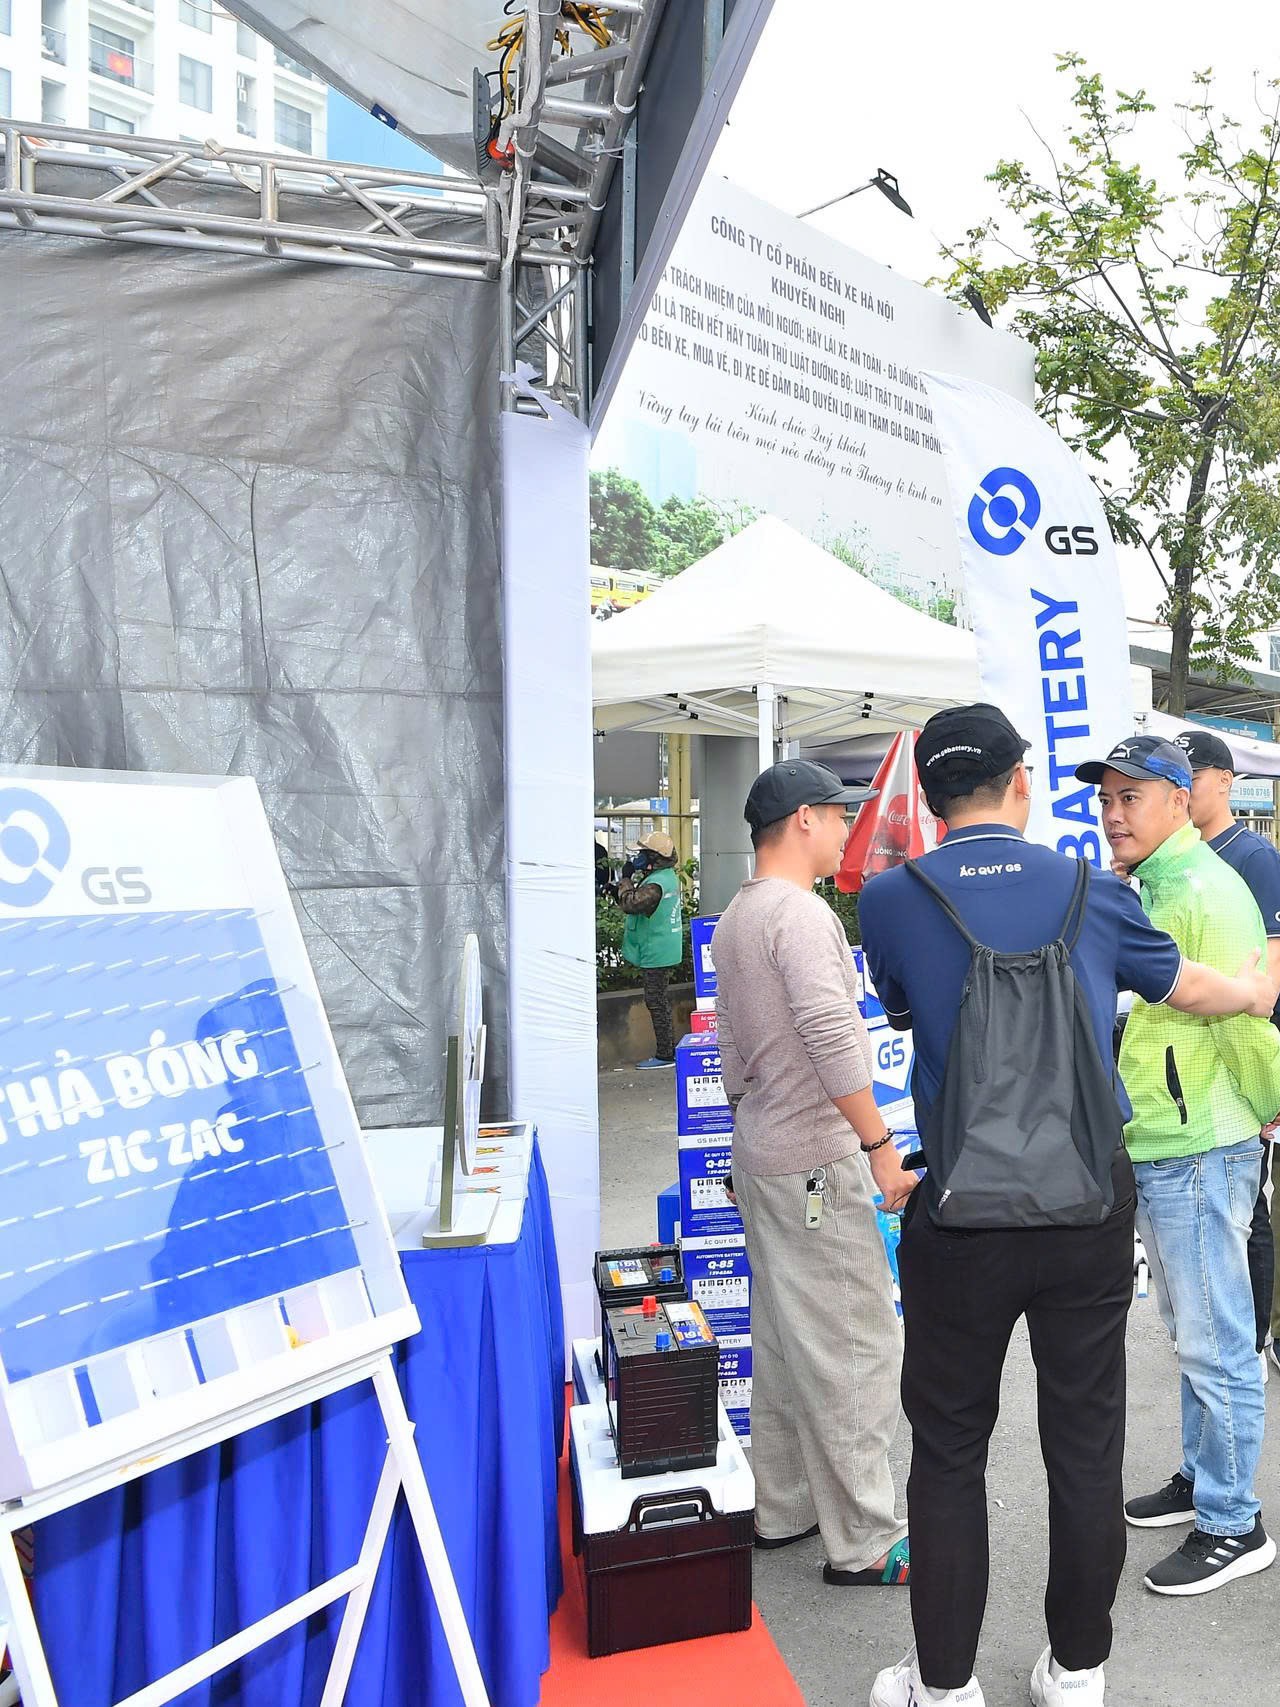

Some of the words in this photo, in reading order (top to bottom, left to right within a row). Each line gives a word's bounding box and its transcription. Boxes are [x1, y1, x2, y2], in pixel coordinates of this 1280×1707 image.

[711, 216, 745, 248] CÔNG
[749, 234, 763, 256] TY
[767, 242, 782, 266] CỔ
[820, 270, 841, 296] BẾN
[845, 282, 857, 304] XE
[861, 291, 874, 312] HÀ
[877, 299, 894, 323] NỘI
[670, 266, 701, 296] TRÁCH
[704, 281, 734, 311] NHIỆM
[737, 292, 755, 320] CỦA
[806, 327, 822, 349] HÃY
[824, 334, 836, 356] LÁI
[838, 341, 848, 360] XE
[850, 347, 860, 366] AN
[862, 352, 882, 375] TOÀN
[771, 276, 816, 313] KHUYẾN
[820, 299, 845, 330] NGHỊ
[664, 296, 677, 320] LÀ
[679, 303, 704, 331] TRÊN
[707, 313, 724, 339] HẾT
[727, 323, 744, 347] HÃY
[746, 332, 769, 358] TUÂN
[772, 342, 788, 366] THỦ
[790, 350, 810, 376] LUẬT
[904, 400, 914, 417] AN
[915, 403, 933, 425] TOÀN
[651, 324, 671, 352] BẾN
[674, 335, 690, 361] XE,
[693, 343, 714, 368] MUA
[733, 358, 742, 378] ĐI
[745, 362, 756, 384] XE
[772, 370, 791, 397] ĐẢM
[793, 378, 810, 404] BẢO
[854, 405, 867, 426] KHI
[868, 411, 889, 434] THAM
[890, 420, 903, 440] GIA
[904, 426, 920, 446] GIAO
[639, 389, 673, 425] Vững
[678, 405, 701, 433] tay
[705, 412, 723, 434] lái
[727, 421, 750, 443] trên
[755, 438, 778, 456] mọi
[840, 462, 852, 477] và
[907, 481, 927, 501] bình
[930, 497, 943, 507] an
[745, 402, 777, 427] Kính
[782, 416, 807, 437] chúc
[810, 424, 833, 452] Quý
[837, 434, 867, 459] khách
[1045, 525, 1099, 556] GS
[1030, 587, 1101, 869] BATTERY
[926, 745, 982, 767] www.gsbattery.vn
[81, 866, 152, 905] GS
[978, 864, 1003, 875] QUY
[1005, 863, 1022, 873] GS
[106, 1029, 259, 1109] BÓNG
[702, 1057, 721, 1067] Q-8
[878, 1037, 905, 1070] GS
[79, 1129, 158, 1184] ZIC
[160, 1112, 244, 1166] ZAC
[709, 1136, 733, 1144] BATTER
[706, 1159, 732, 1169] Q-85
[708, 1260, 734, 1269] Q-85
[718, 1361, 738, 1370] -85
[1060, 1679, 1088, 1690] DODGERS
